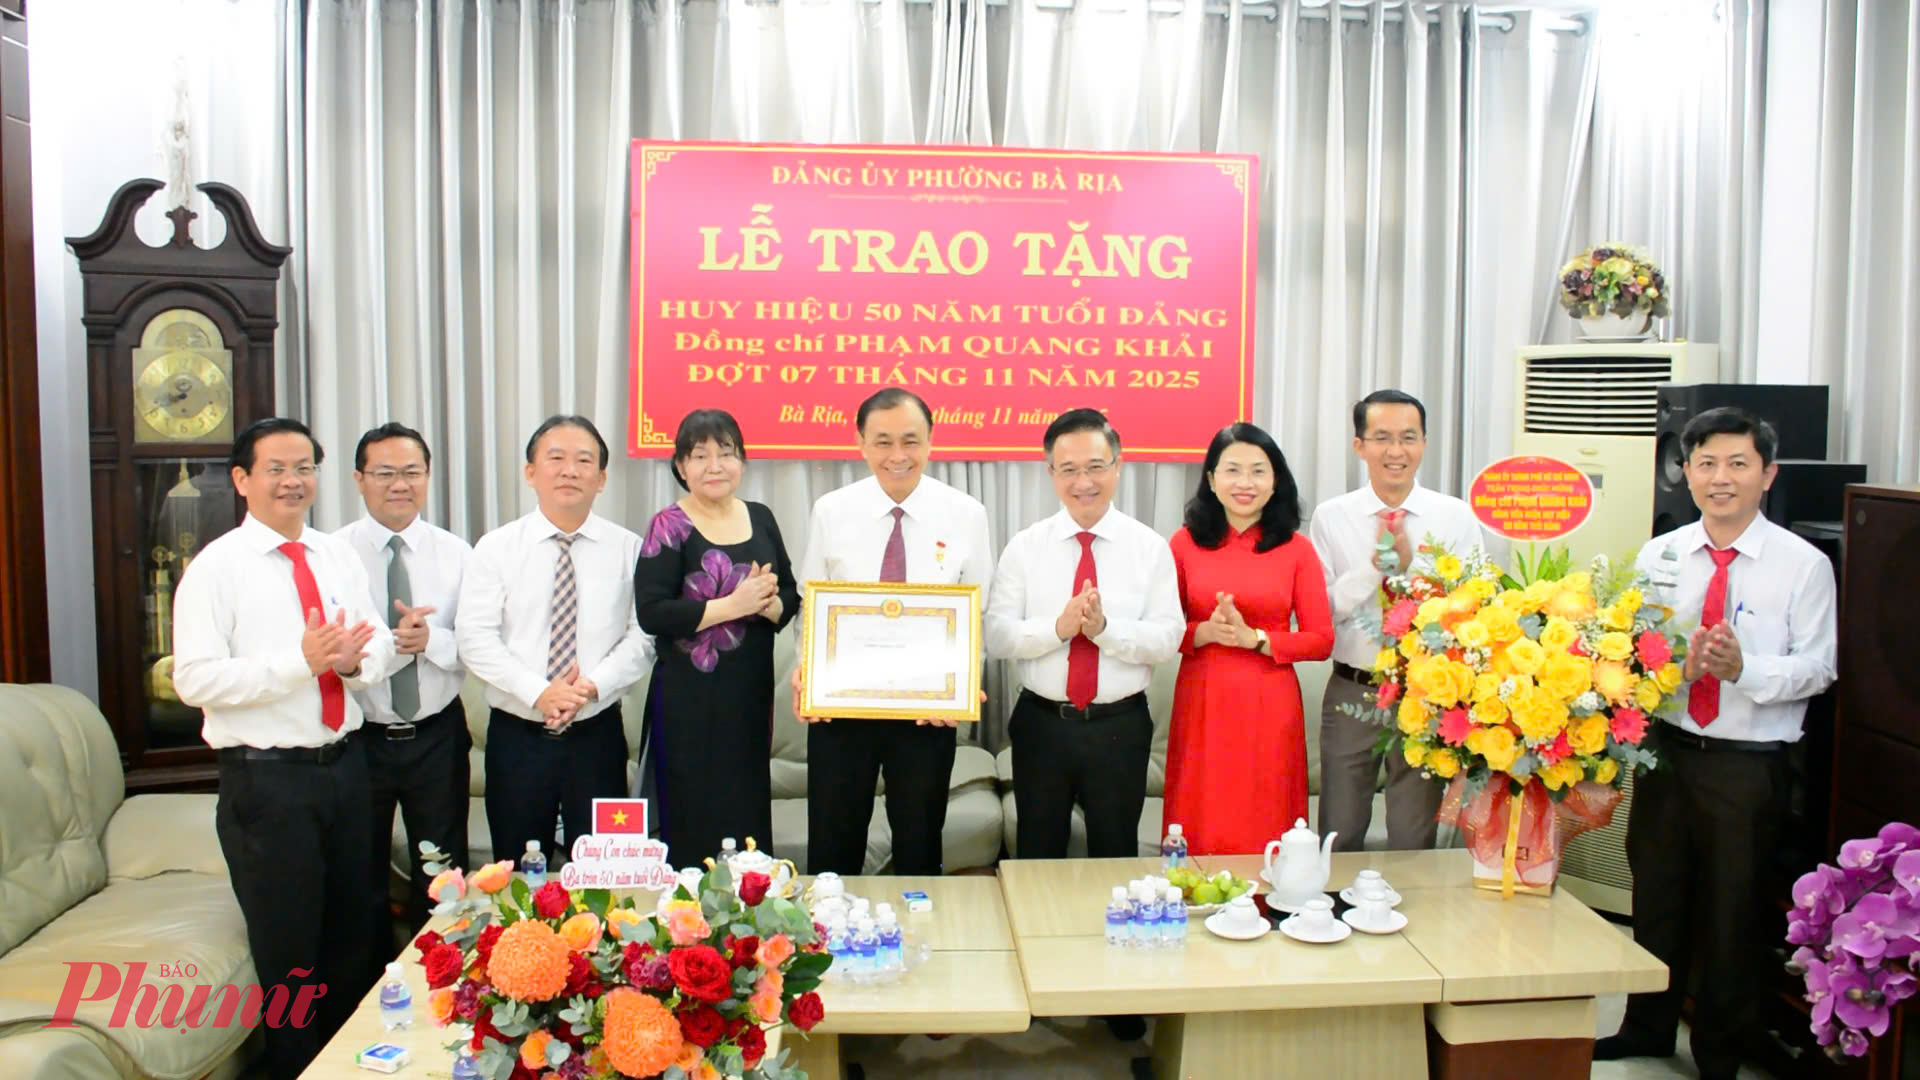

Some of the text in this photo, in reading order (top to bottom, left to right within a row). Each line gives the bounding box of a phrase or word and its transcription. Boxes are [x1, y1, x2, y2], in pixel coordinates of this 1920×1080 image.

[771, 162, 1124, 194] ĐẢNG ỦY PHƯỜNG BÀ RỊA
[698, 203, 1193, 289] LỄ TRAO TẶNG
[659, 296, 1229, 329] HUY HIỆU 50 NĂM TUỔI ĐẢNG
[674, 328, 1213, 358] Đồng chí PHẠM QUANG KHẢI
[688, 358, 1201, 388] ĐỢT 07 THÁNG 11 NĂM 2025
[779, 405, 804, 422] Bà
[811, 405, 848, 427] Rịa,
[991, 407, 1012, 425] 11
[604, 838, 620, 860] Con
